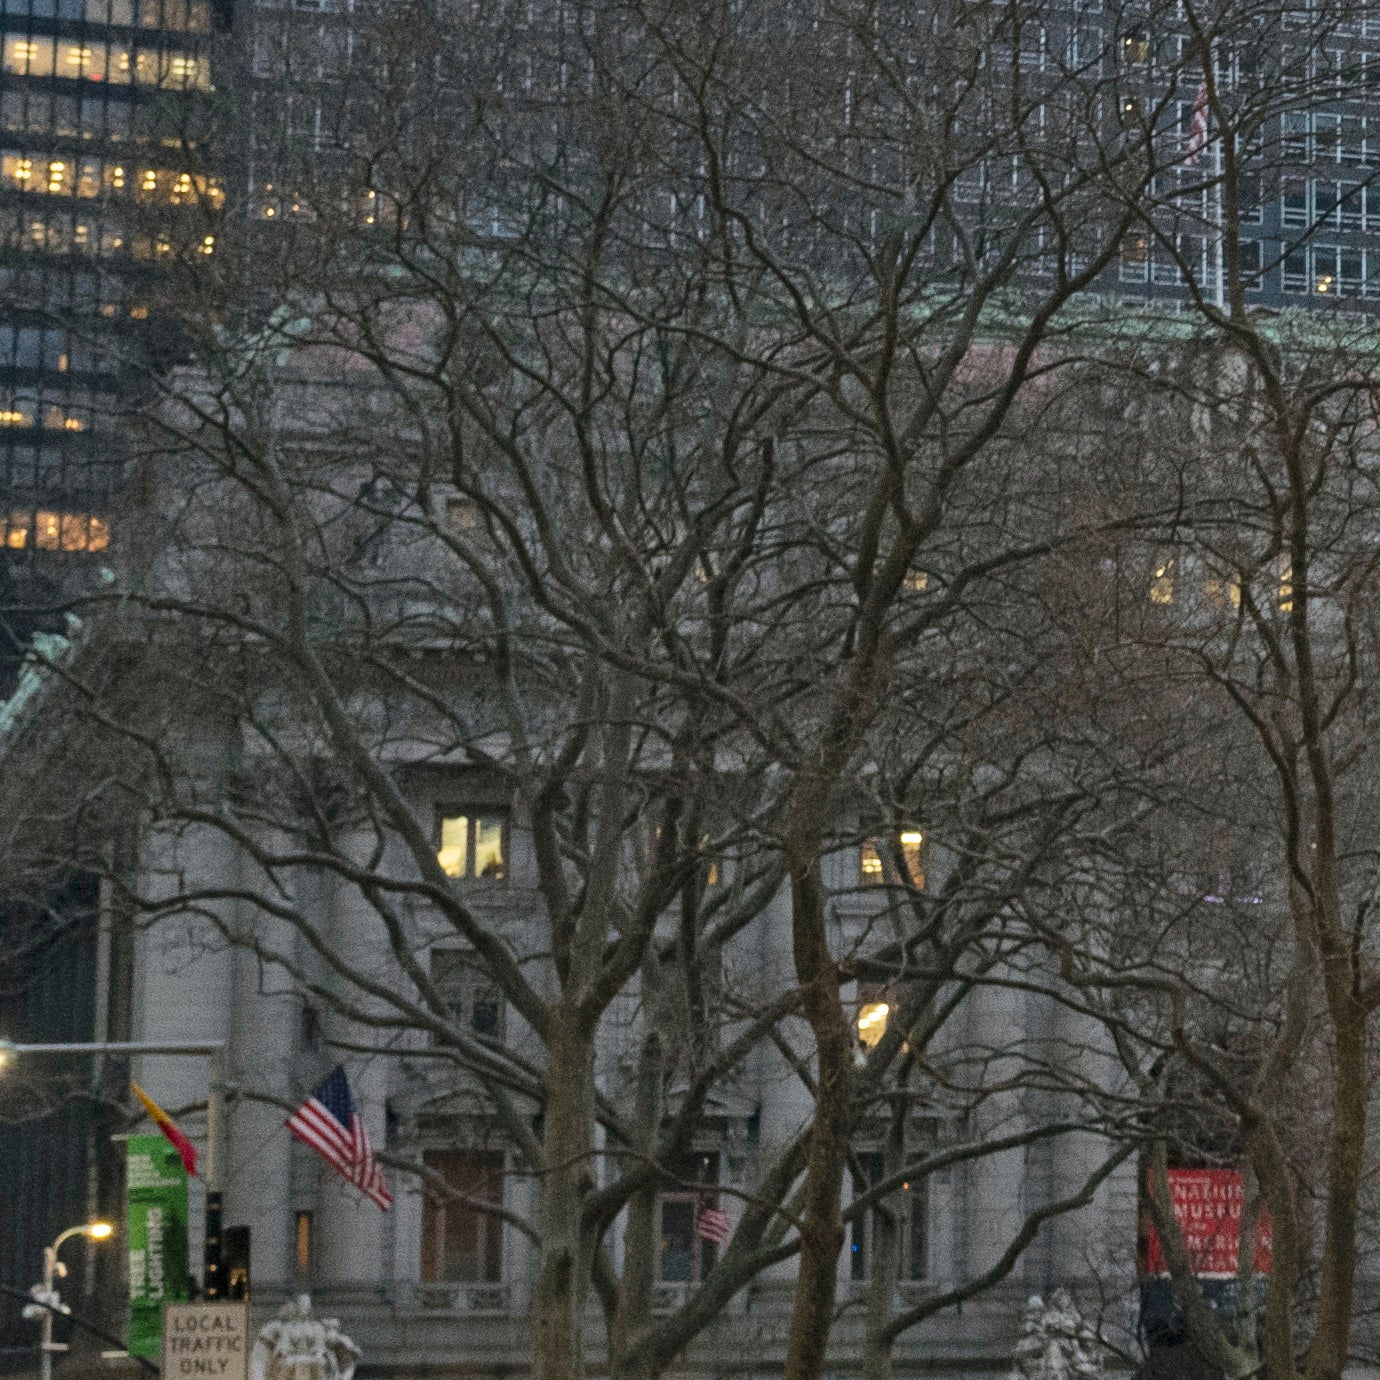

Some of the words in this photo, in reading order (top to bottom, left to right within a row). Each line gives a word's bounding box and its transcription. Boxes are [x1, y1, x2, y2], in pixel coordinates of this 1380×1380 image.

[147, 1206, 164, 1299] LIGHTING
[173, 1314, 238, 1332] LOCAL
[169, 1335, 242, 1353] TRAFFIC
[180, 1358, 229, 1375] ONLY
